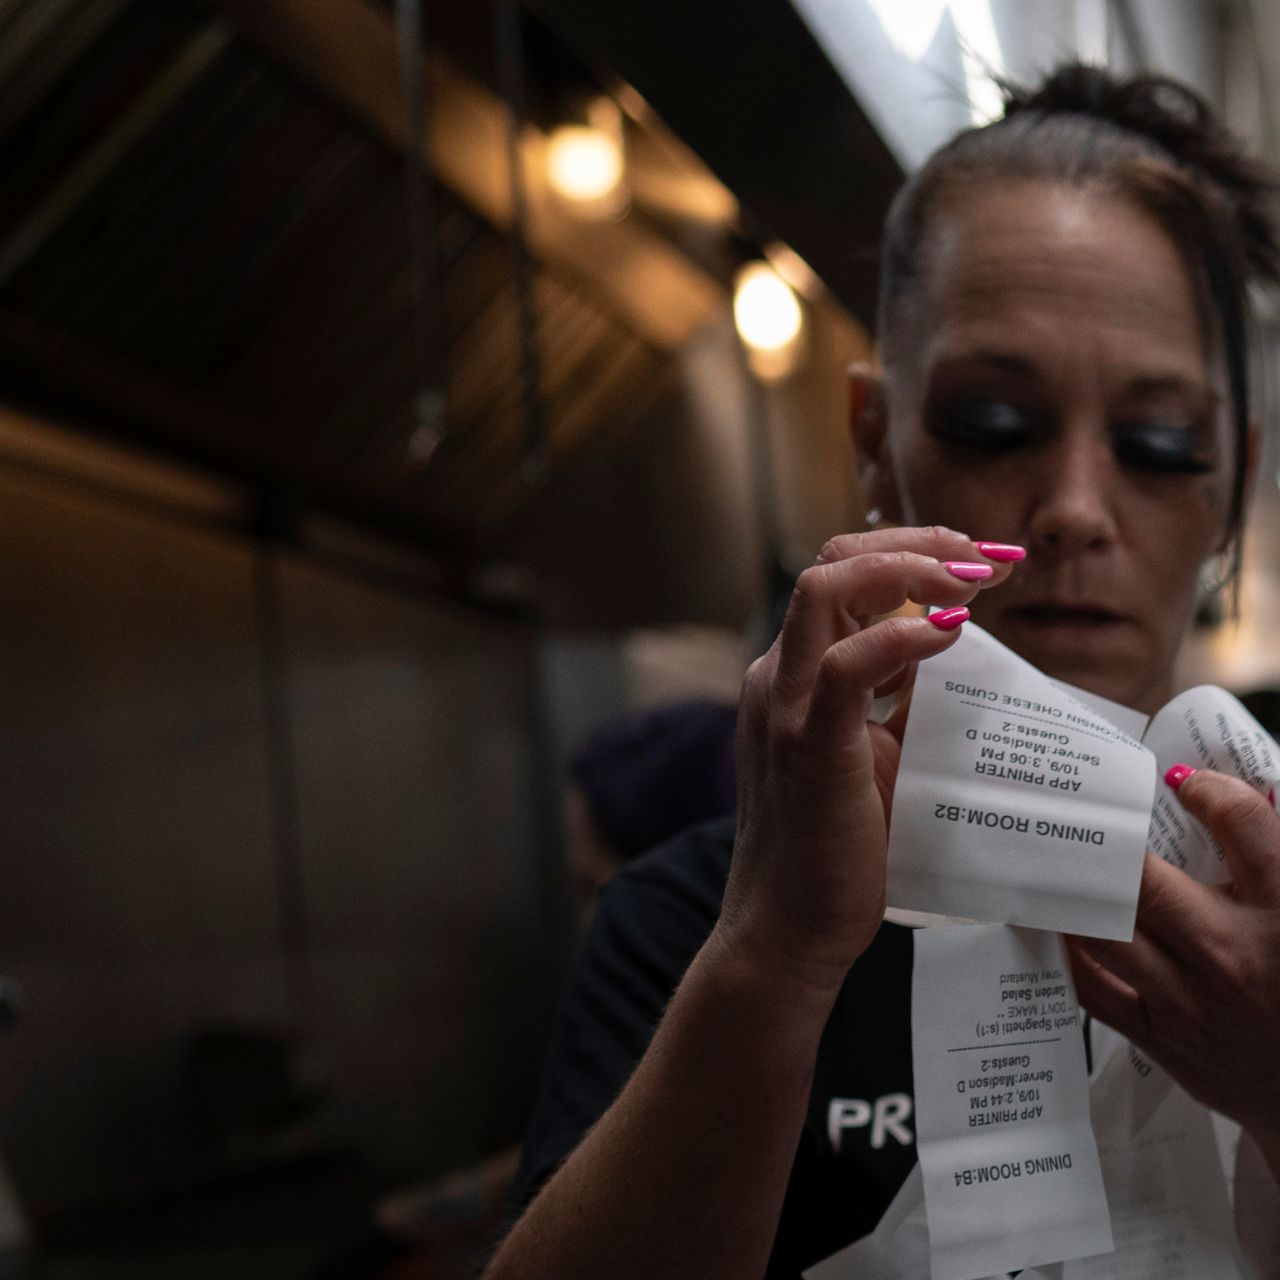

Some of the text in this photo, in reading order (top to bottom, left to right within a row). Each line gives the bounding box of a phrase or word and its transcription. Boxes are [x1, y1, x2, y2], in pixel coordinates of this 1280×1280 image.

[945, 681, 998, 701] CURDS
[1002, 695, 1062, 717] CHEESE
[1002, 721, 1069, 745] Guests:2
[966, 729, 1100, 766] Server:Madison D
[981, 747, 1079, 775] 10/9, 3:06 PM
[975, 761, 1082, 792] APP PRINTER
[934, 803, 1105, 845] DINING ROOM:B2
[1000, 971, 1039, 985] Mustard
[1002, 989, 1031, 1002] Salad
[1008, 1005, 1038, 1018] MAKE
[976, 1021, 999, 1038] (s:1)
[1002, 1018, 1052, 1036] Spaghetti
[981, 1055, 1030, 1072] Guests:2
[957, 1069, 1053, 1093] Server:Madison D
[970, 1089, 1040, 1109] 10/9, 2:44 PM
[827, 1093, 915, 1152] PR
[969, 1105, 1043, 1127] APP PRINTER
[954, 1153, 1072, 1187] DINING ROOM:B4
